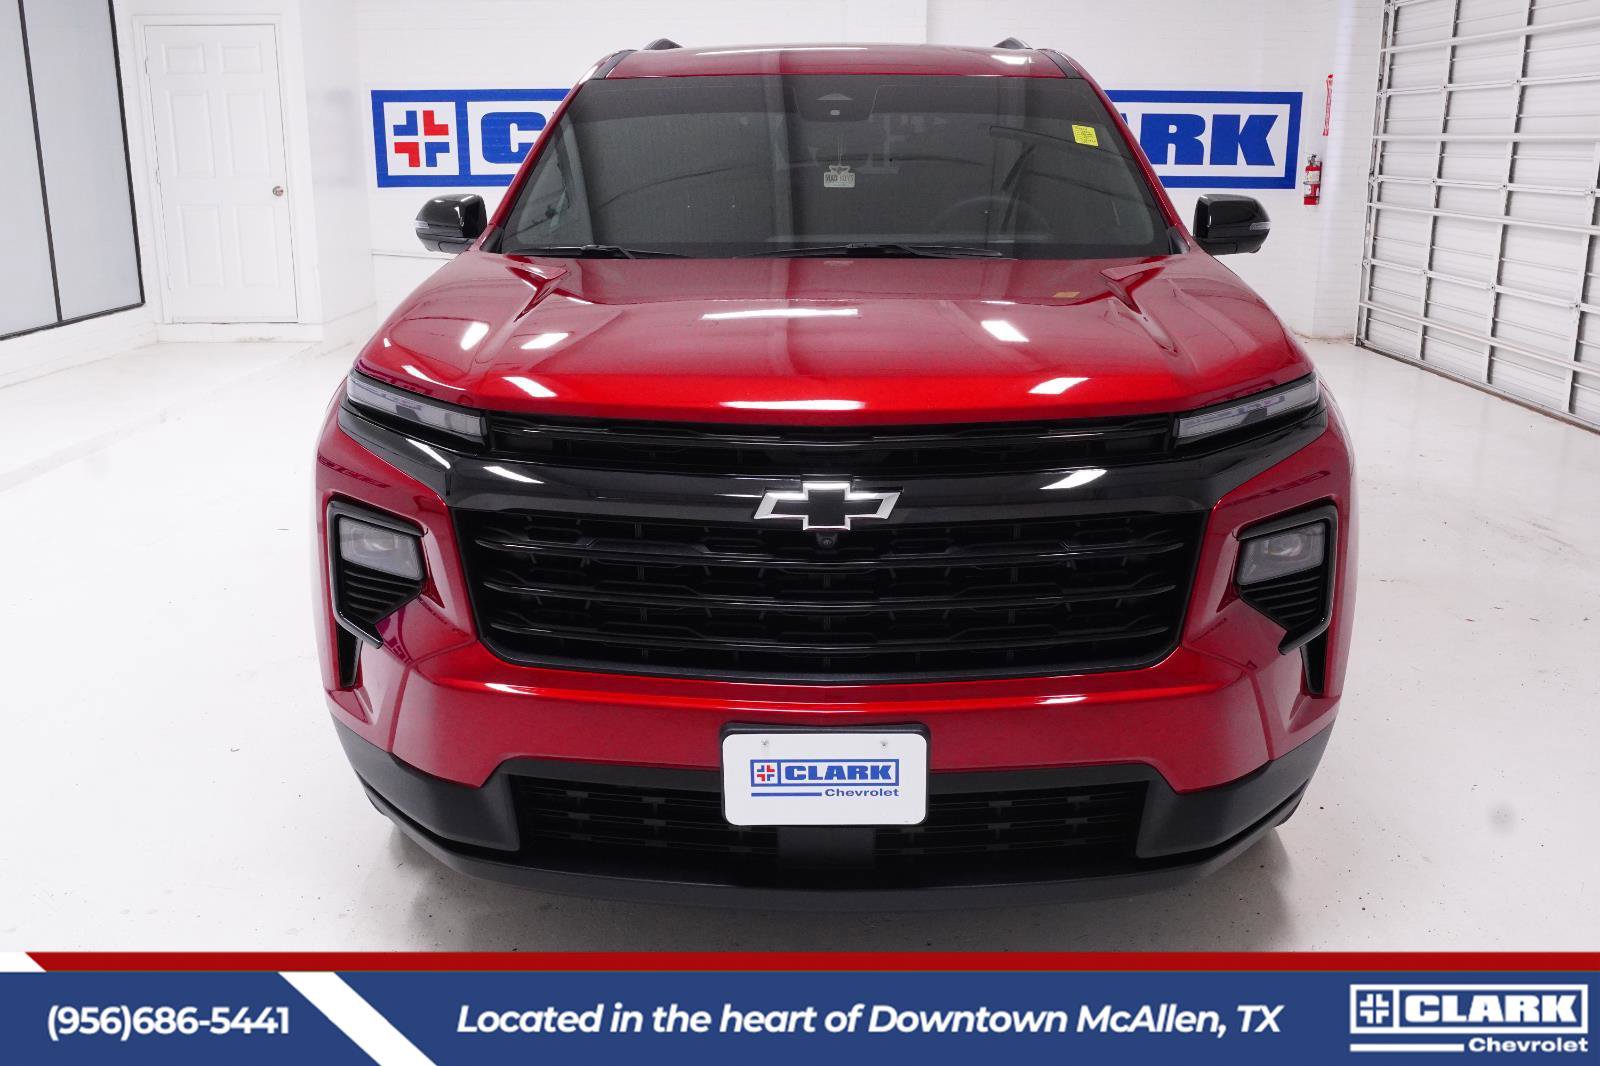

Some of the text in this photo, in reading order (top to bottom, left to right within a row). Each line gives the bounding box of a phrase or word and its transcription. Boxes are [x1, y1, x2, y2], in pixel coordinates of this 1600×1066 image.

[1120, 113, 1278, 166] RK
[785, 764, 892, 781] CLARK
[825, 788, 899, 797] Chevrolet
